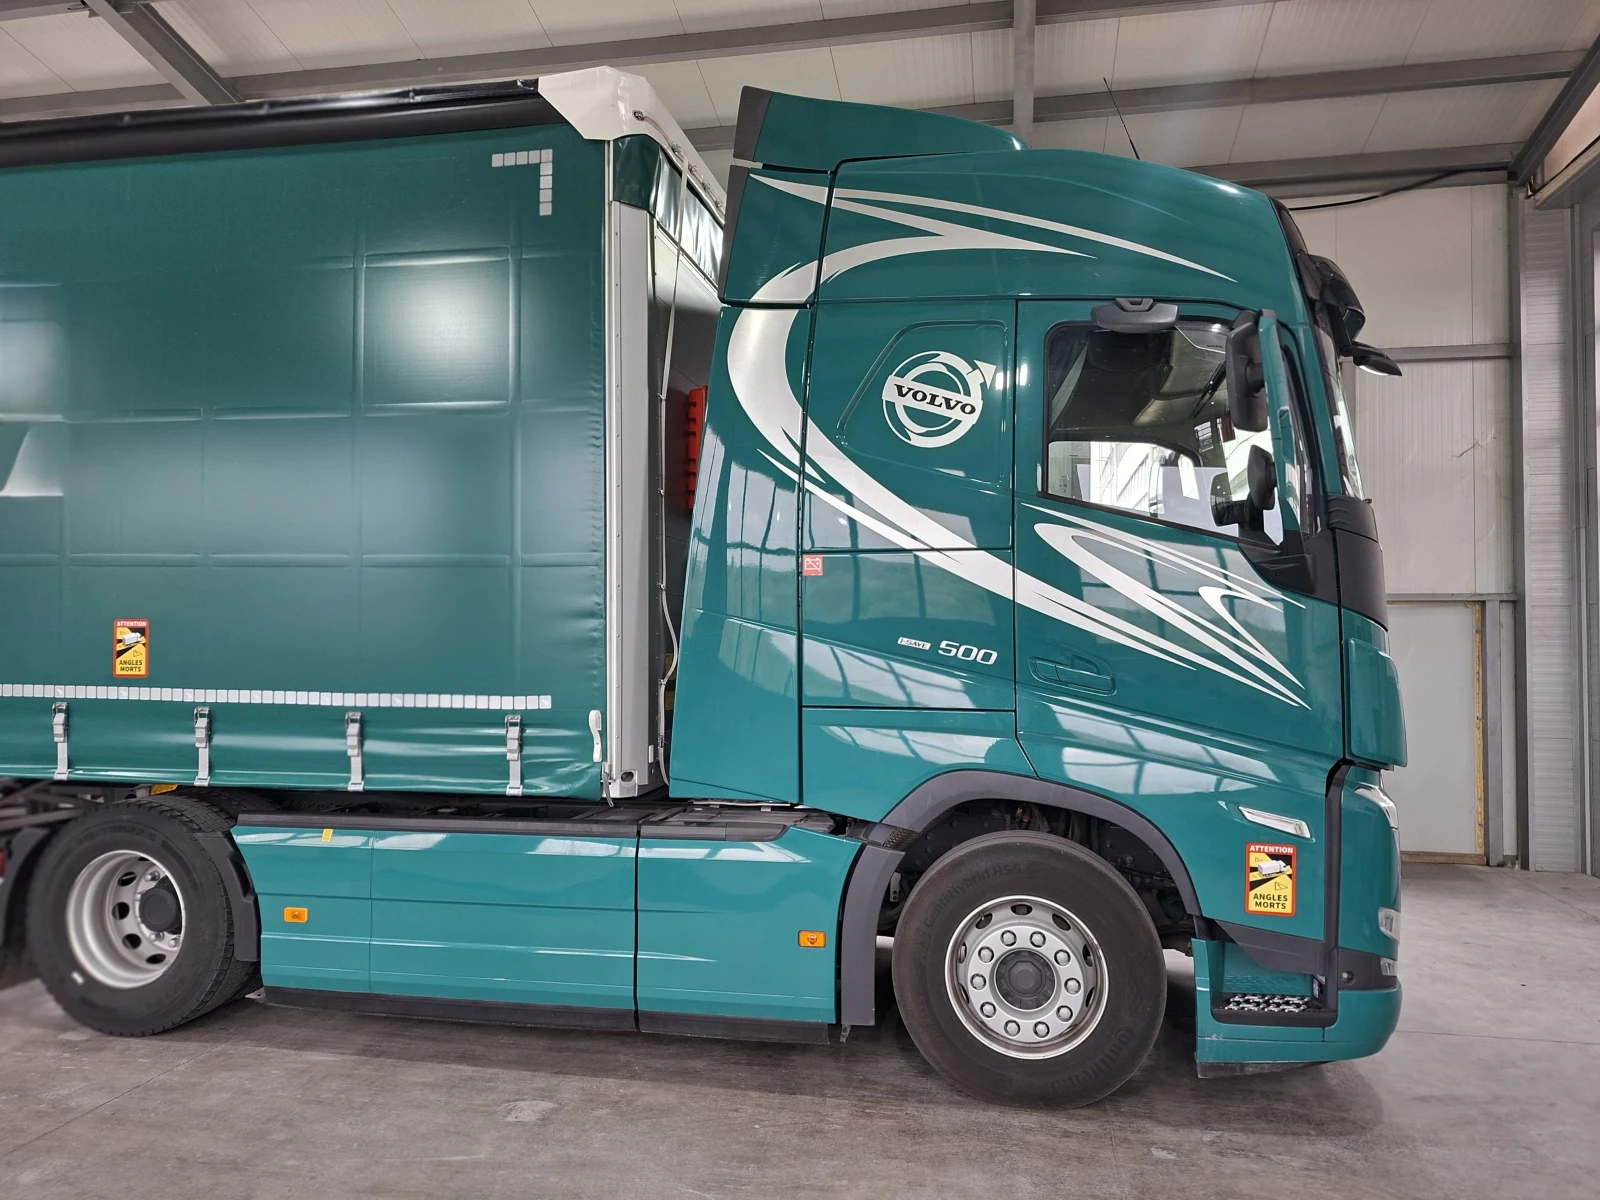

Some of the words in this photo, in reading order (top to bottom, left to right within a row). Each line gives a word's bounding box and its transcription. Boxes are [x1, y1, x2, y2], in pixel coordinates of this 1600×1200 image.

[893, 383, 976, 415] VOLVO
[899, 638, 929, 649] I-SAVE
[938, 640, 998, 665] 500
[1249, 845, 1294, 854] ATTENTION
[1253, 892, 1288, 902] ANGLES
[1254, 901, 1287, 910] MORTS
